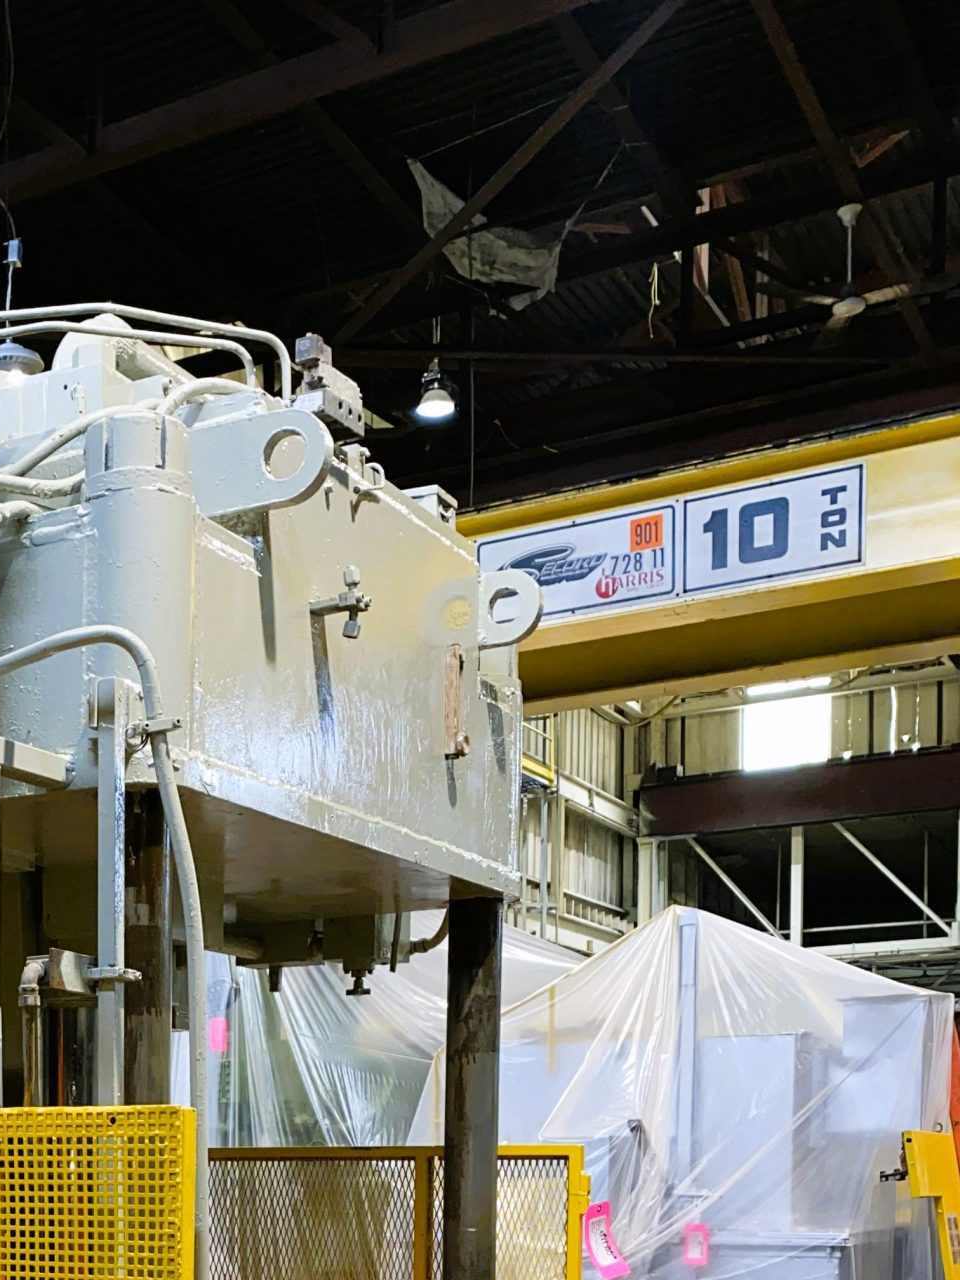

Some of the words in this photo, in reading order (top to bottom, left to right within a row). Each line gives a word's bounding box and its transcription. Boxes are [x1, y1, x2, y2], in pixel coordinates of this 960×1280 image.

[634, 521, 659, 546] 901
[703, 496, 789, 570] 10
[820, 485, 848, 551] TON
[610, 552, 642, 576] 728
